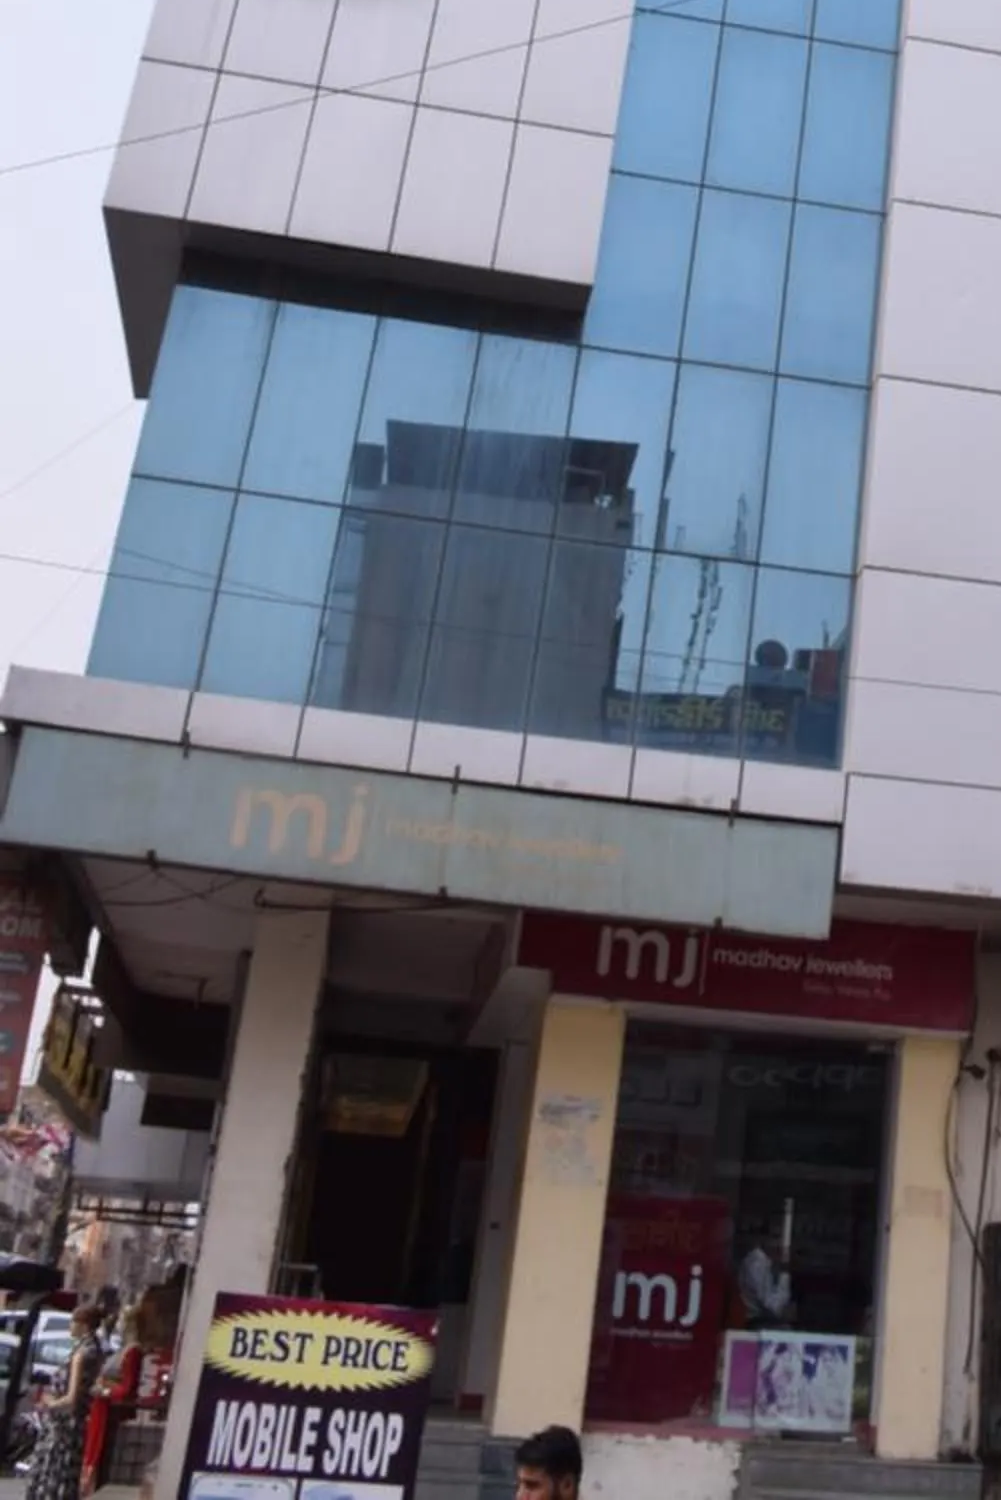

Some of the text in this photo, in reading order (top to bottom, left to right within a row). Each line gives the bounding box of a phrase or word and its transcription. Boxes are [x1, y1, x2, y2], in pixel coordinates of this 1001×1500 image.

[229, 784, 370, 866] mj
[596, 925, 699, 988] mj
[712, 946, 802, 972] madhav
[612, 1263, 704, 1327] mj
[229, 1326, 410, 1372] BEST PRICE
[206, 1399, 404, 1477] MOBILE SHOP
